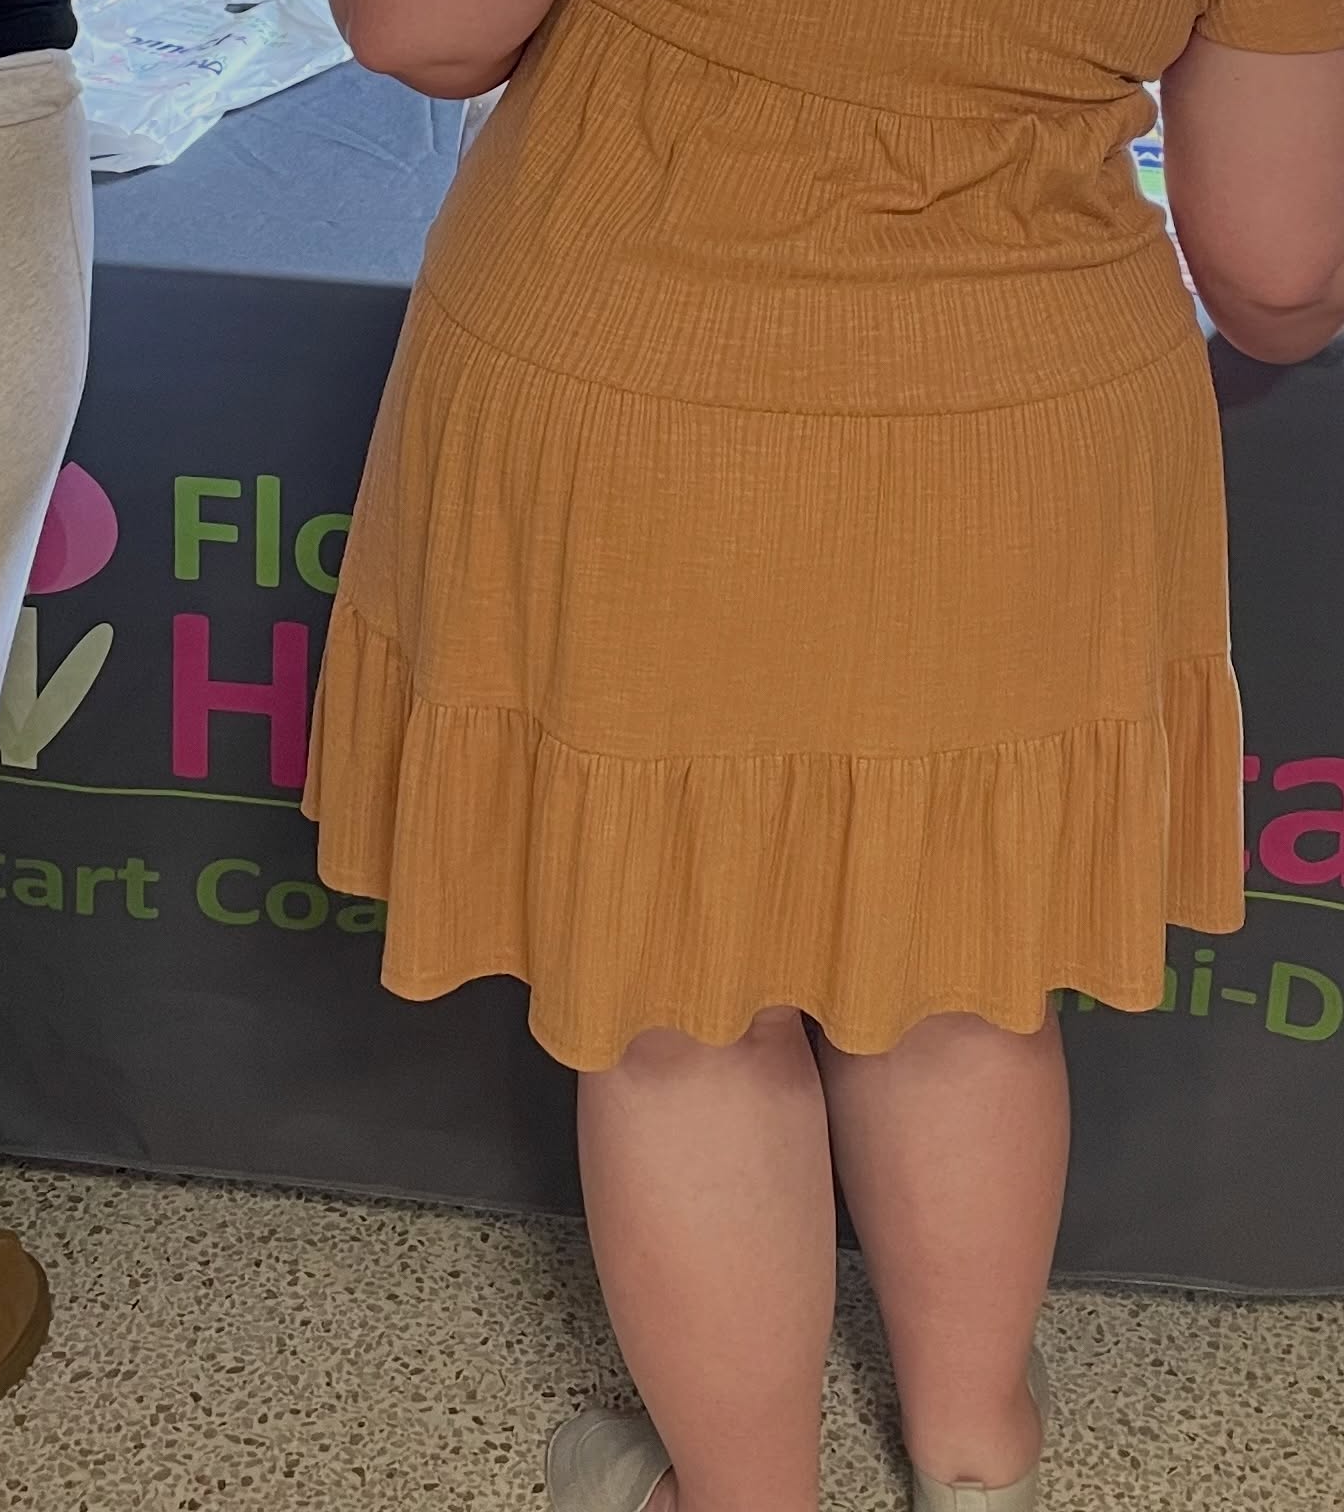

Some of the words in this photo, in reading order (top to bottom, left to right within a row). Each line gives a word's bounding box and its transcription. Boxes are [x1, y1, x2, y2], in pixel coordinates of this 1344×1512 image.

[174, 474, 354, 595] Flo
[172, 613, 309, 788] H
[196, 857, 387, 934] Coa
